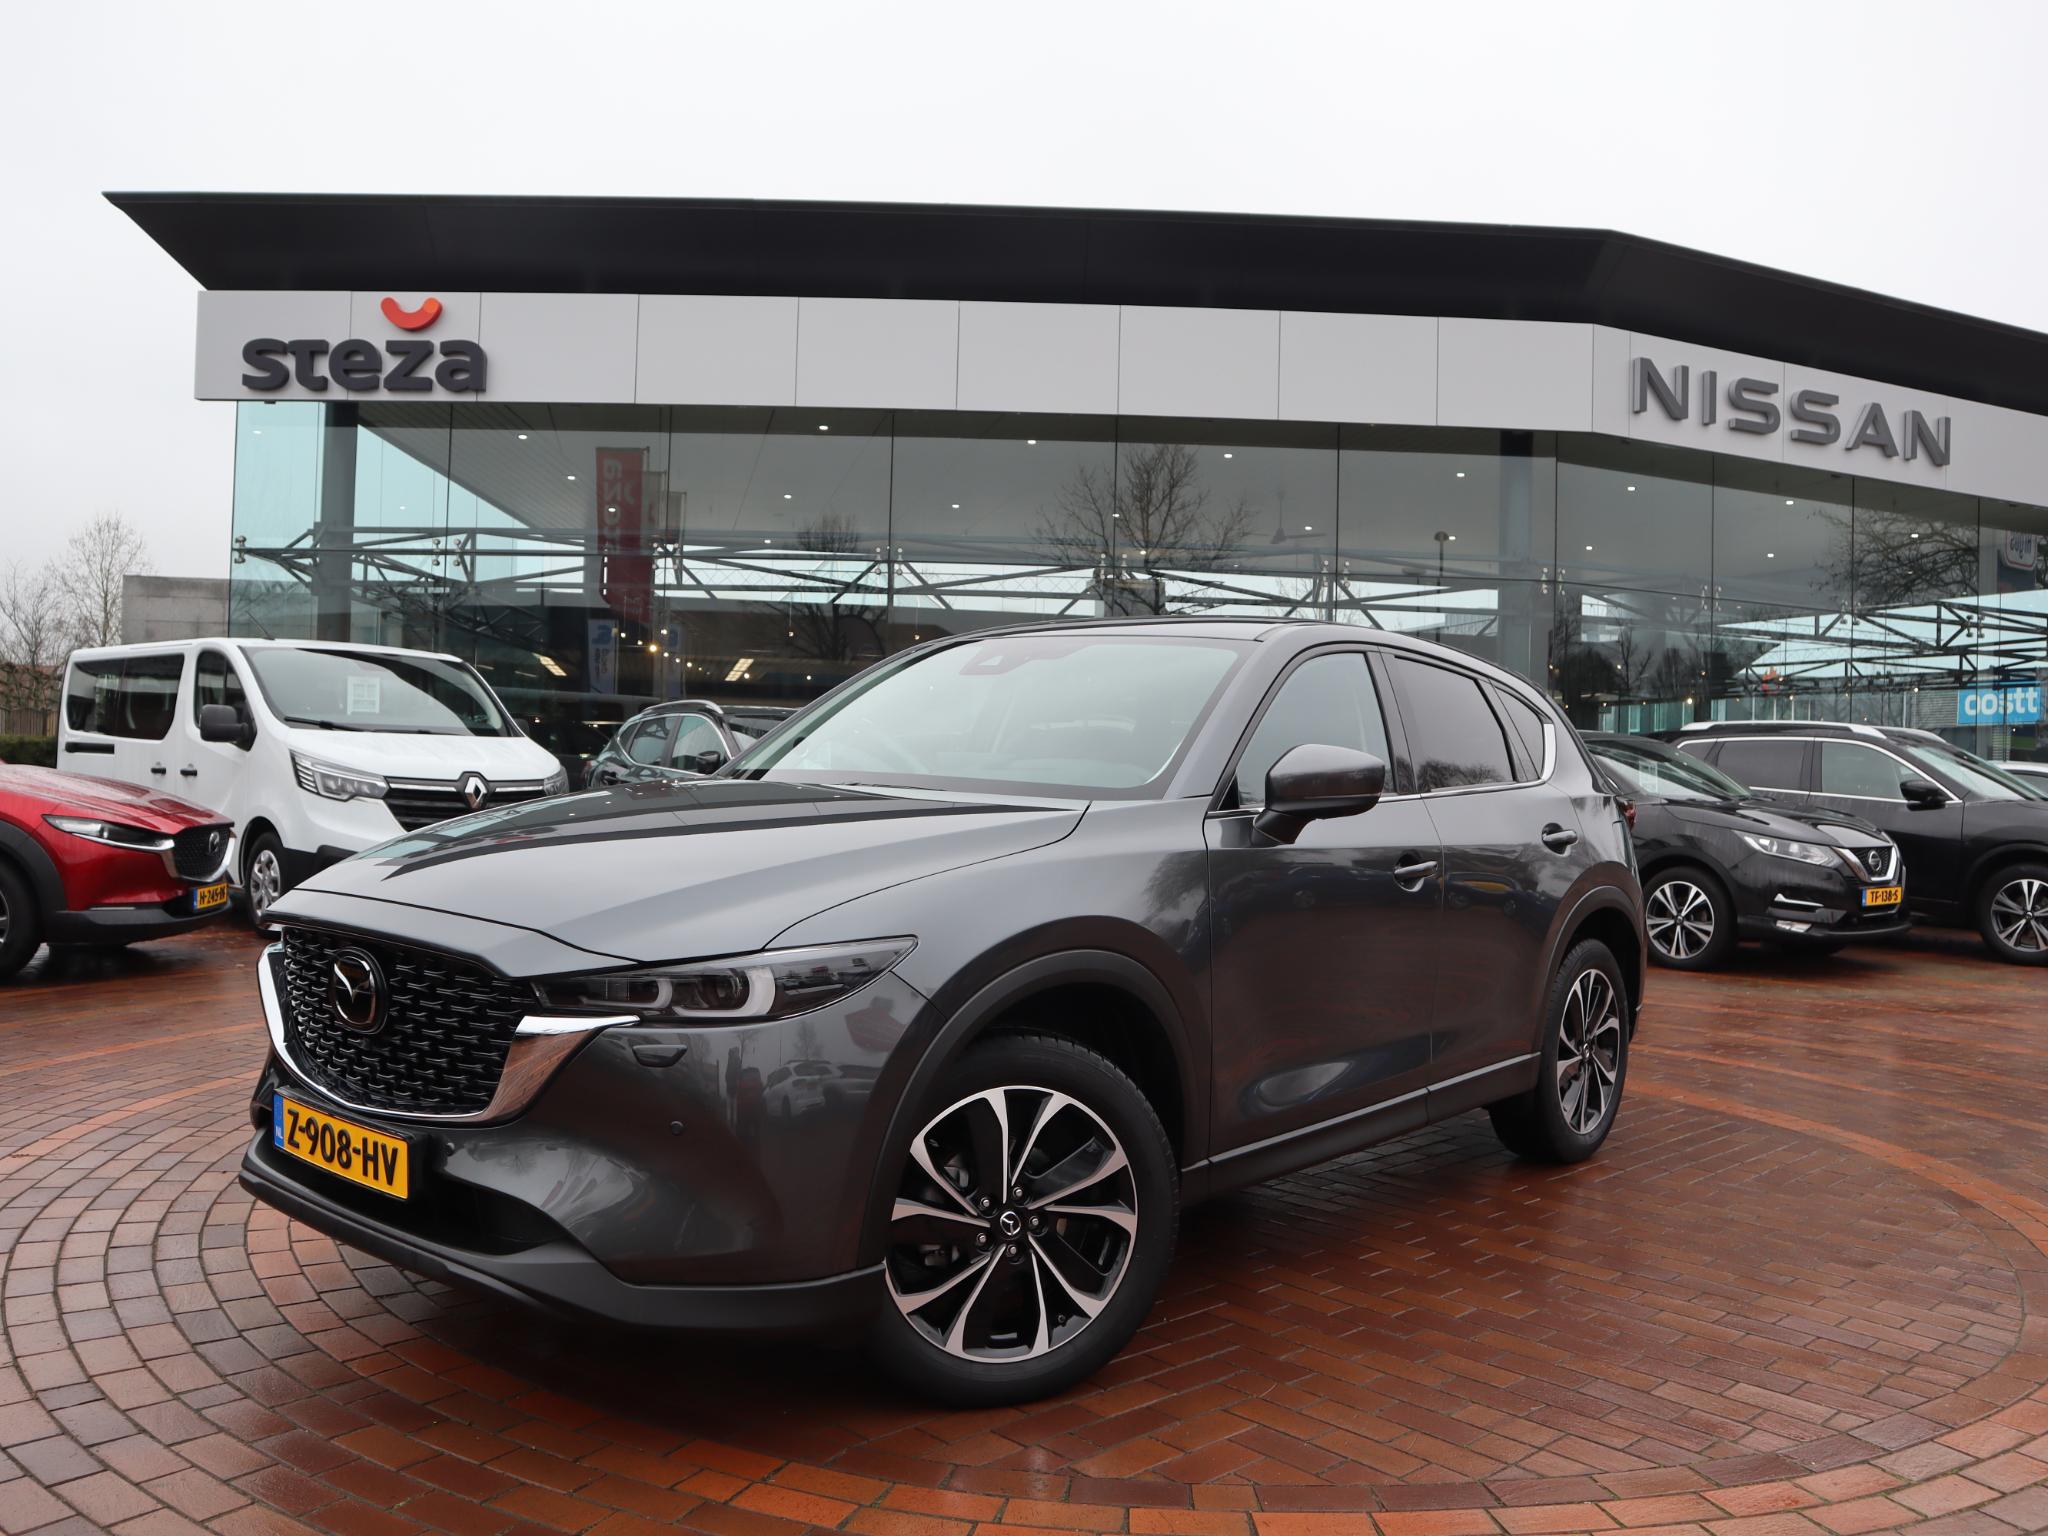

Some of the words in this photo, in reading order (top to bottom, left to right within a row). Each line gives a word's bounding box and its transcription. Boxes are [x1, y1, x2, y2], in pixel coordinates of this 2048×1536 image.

[242, 338, 488, 392] steza
[1632, 356, 1952, 467] NISSAN
[1964, 687, 2038, 716] oostt
[1870, 889, 1899, 903] TF-138-S
[275, 1125, 284, 1140] NL
[287, 1108, 399, 1186] Z-908-HV
